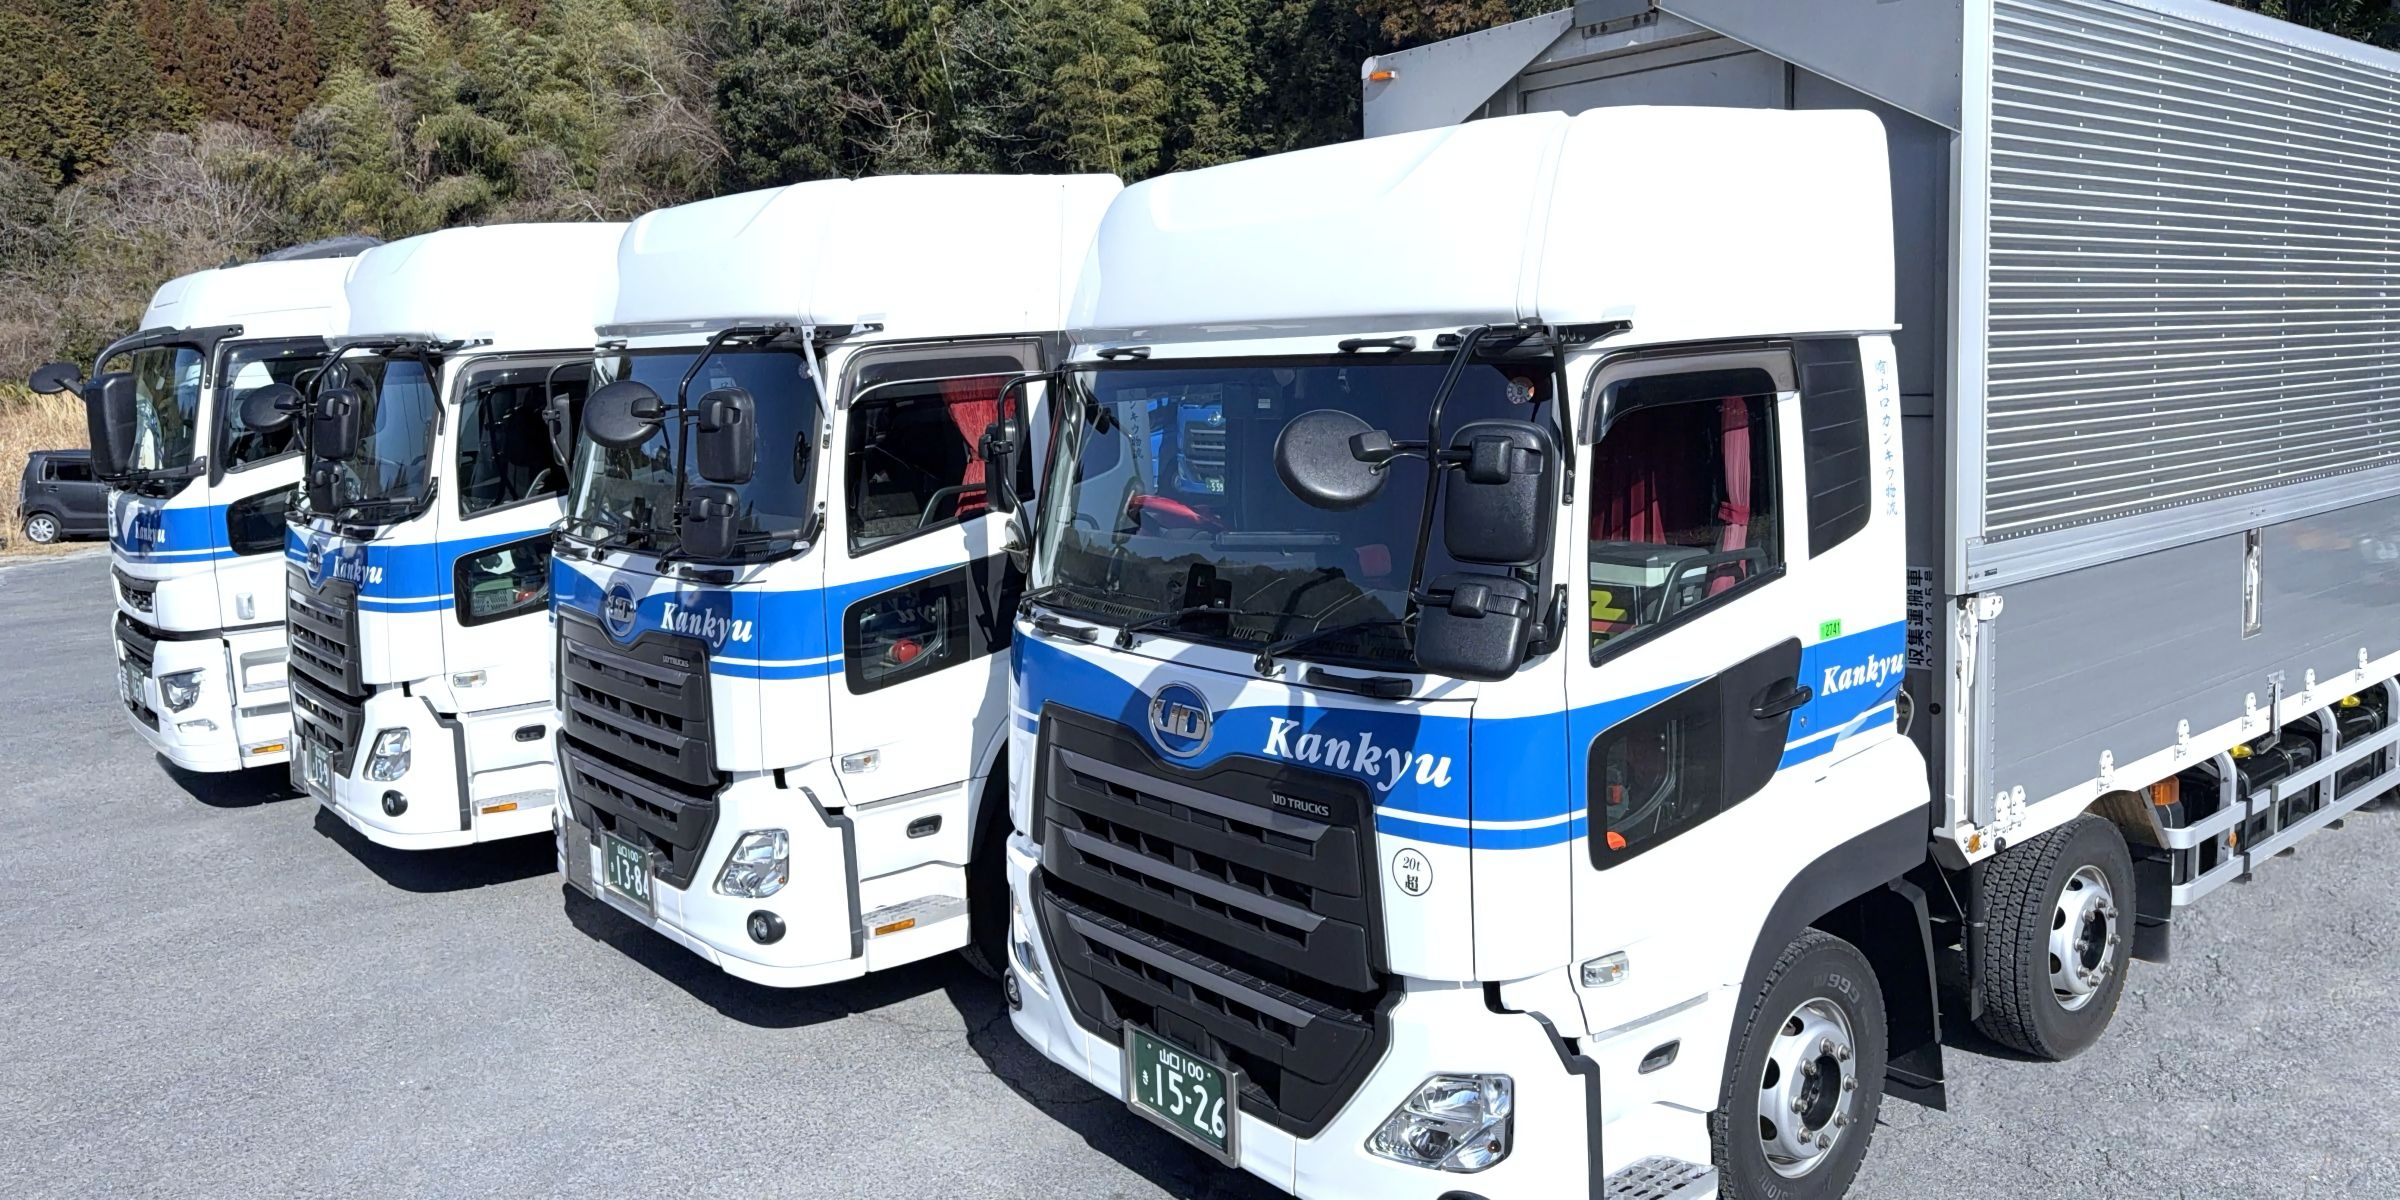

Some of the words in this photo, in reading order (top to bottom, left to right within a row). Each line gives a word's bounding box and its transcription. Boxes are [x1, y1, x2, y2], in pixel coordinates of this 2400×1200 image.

[333, 555, 383, 589] Kankyu
[660, 601, 753, 648] Kankyu
[1820, 652, 1905, 696] Kankyu
[1262, 716, 1452, 792] Kankyu
[1272, 793, 1286, 806] UD
[1287, 797, 1329, 816] TRUCKS
[1402, 856, 1420, 872] 20t
[1405, 874, 1419, 893] 超
